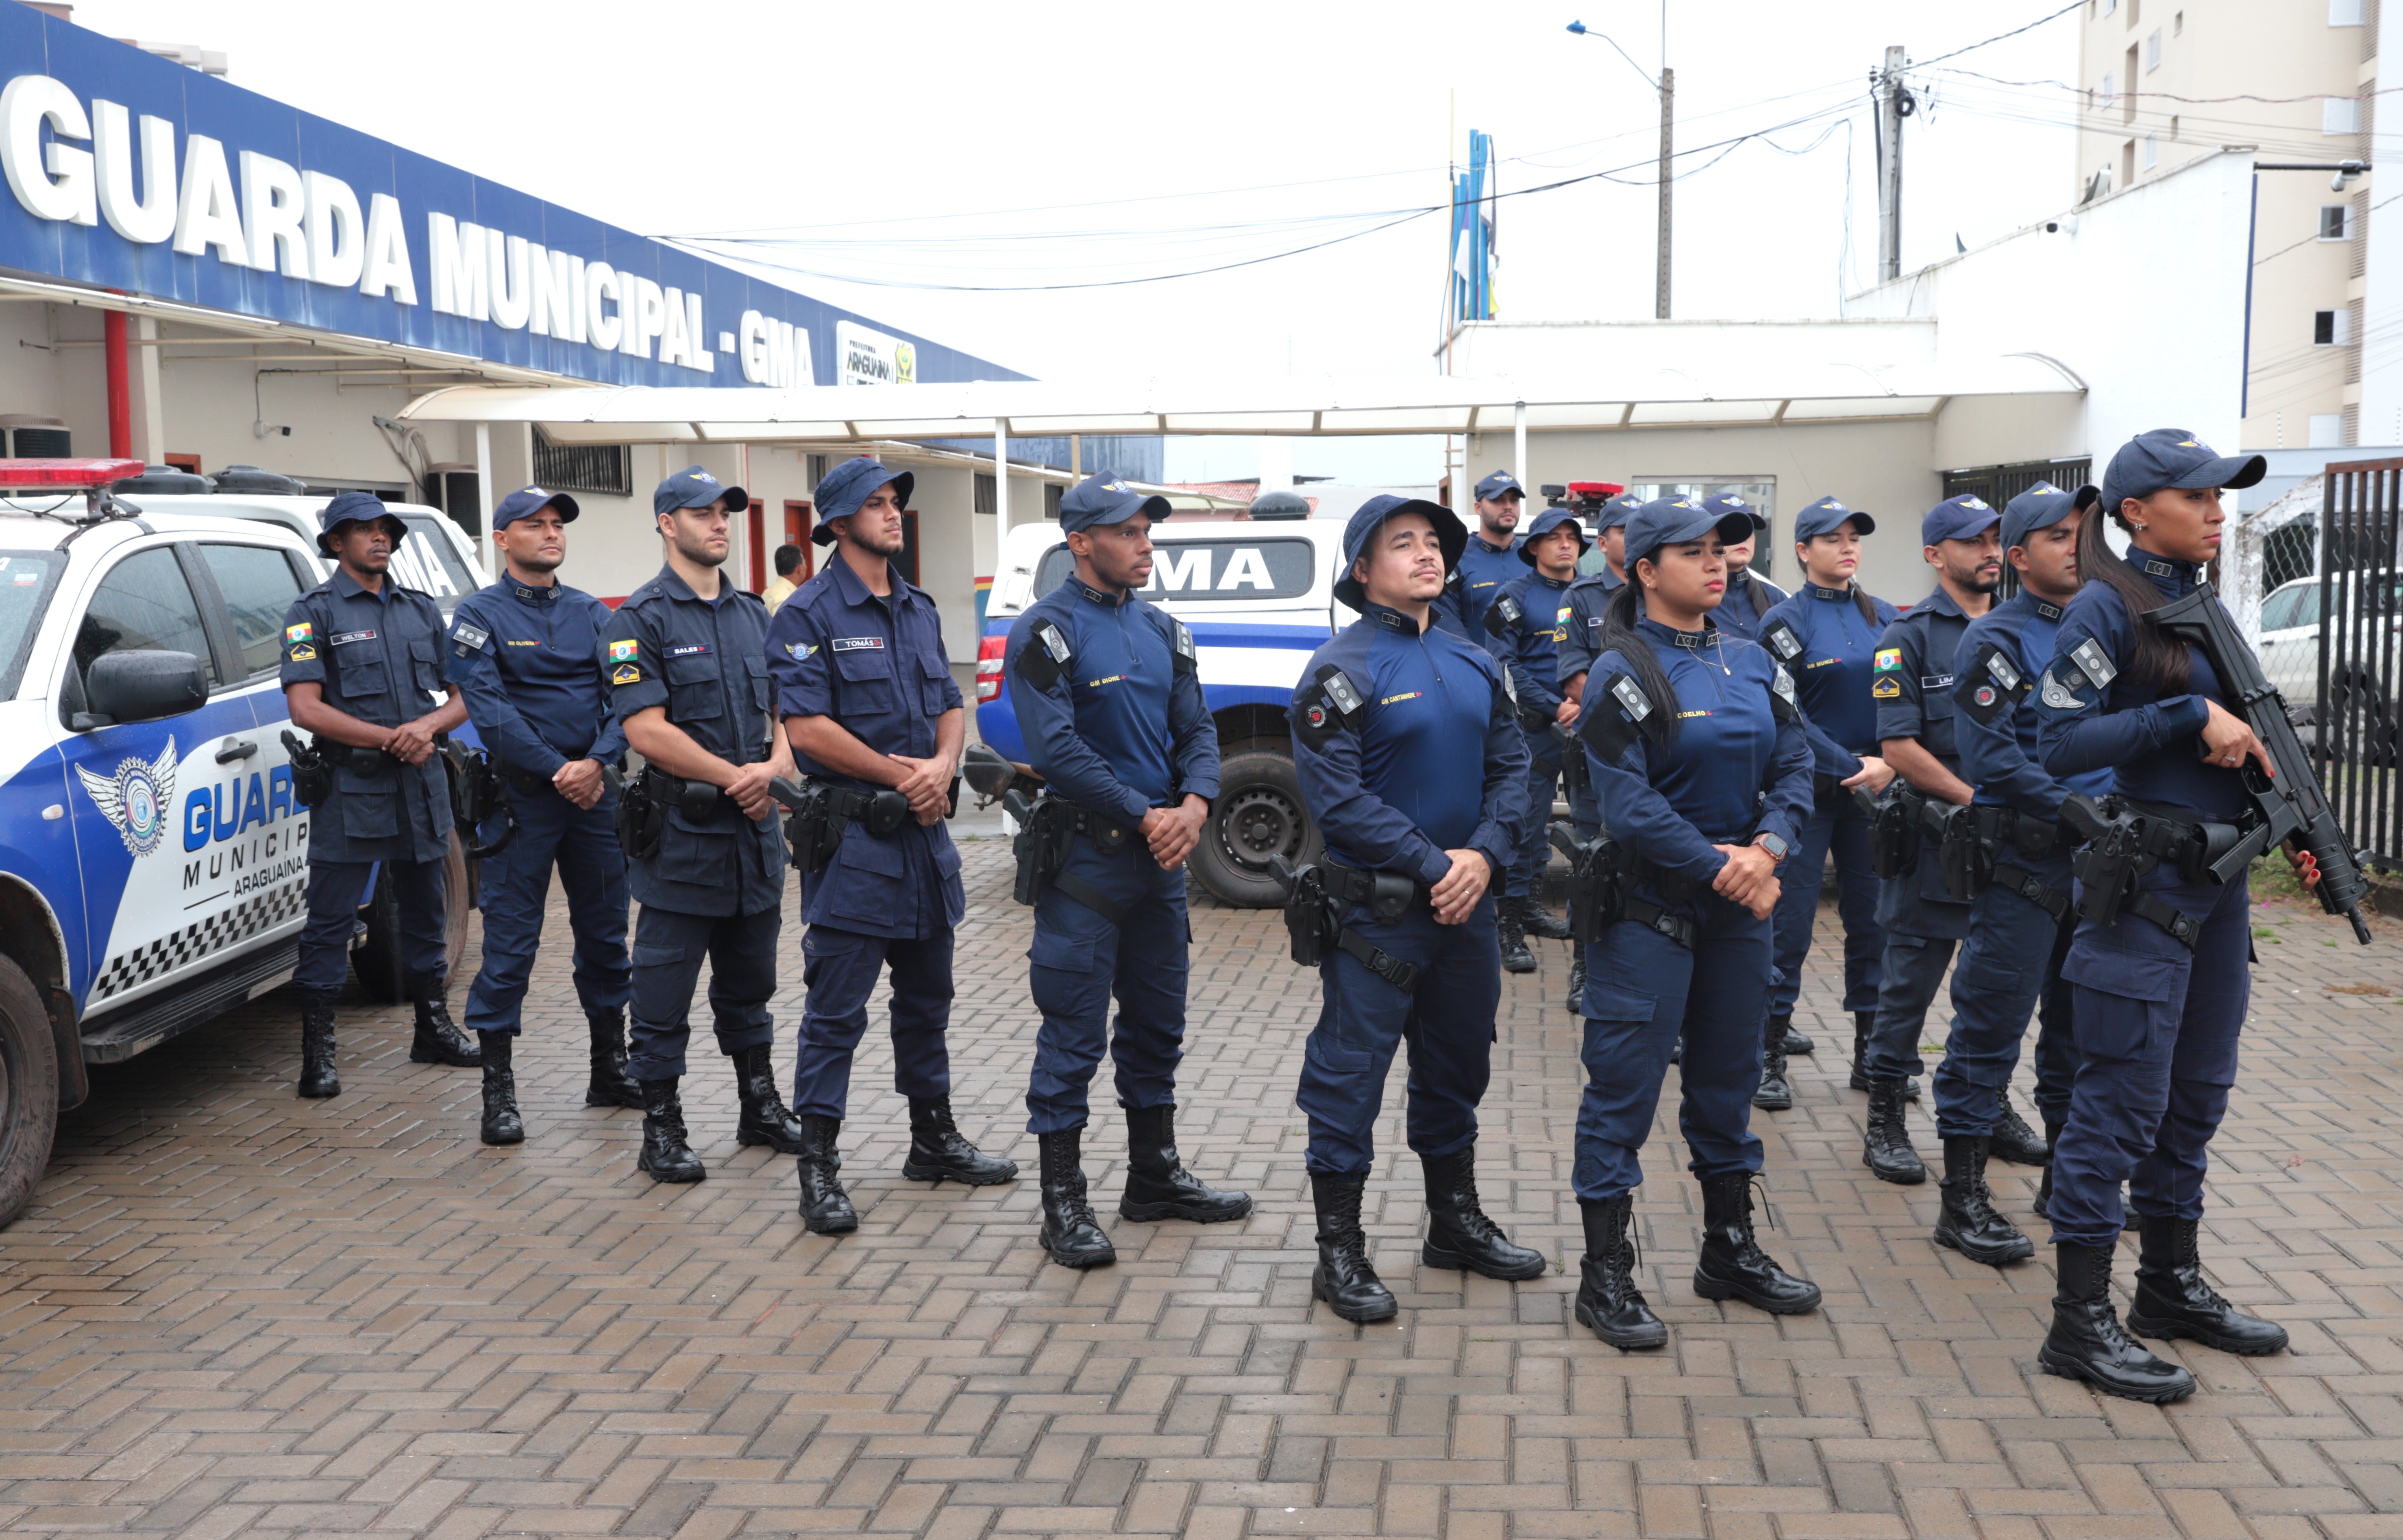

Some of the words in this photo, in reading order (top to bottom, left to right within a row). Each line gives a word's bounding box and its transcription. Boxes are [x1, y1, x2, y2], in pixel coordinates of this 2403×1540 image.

[0, 74, 418, 306] GUARDA
[428, 211, 714, 372] MUNICIPAL
[740, 310, 815, 388] GMA
[849, 339, 876, 354] PREFEITURA
[387, 532, 459, 597] MA
[341, 633, 366, 641] WELTON
[845, 638, 874, 647] TOMÁS
[1816, 659, 1834, 667] MUNIZ
[1101, 675, 1120, 684] DIONE
[121, 773, 131, 803] GUARDA
[130, 770, 156, 793] MUNICIPAL
[184, 764, 310, 853] GUAR
[234, 855, 304, 898] ARAGUAÍNA
